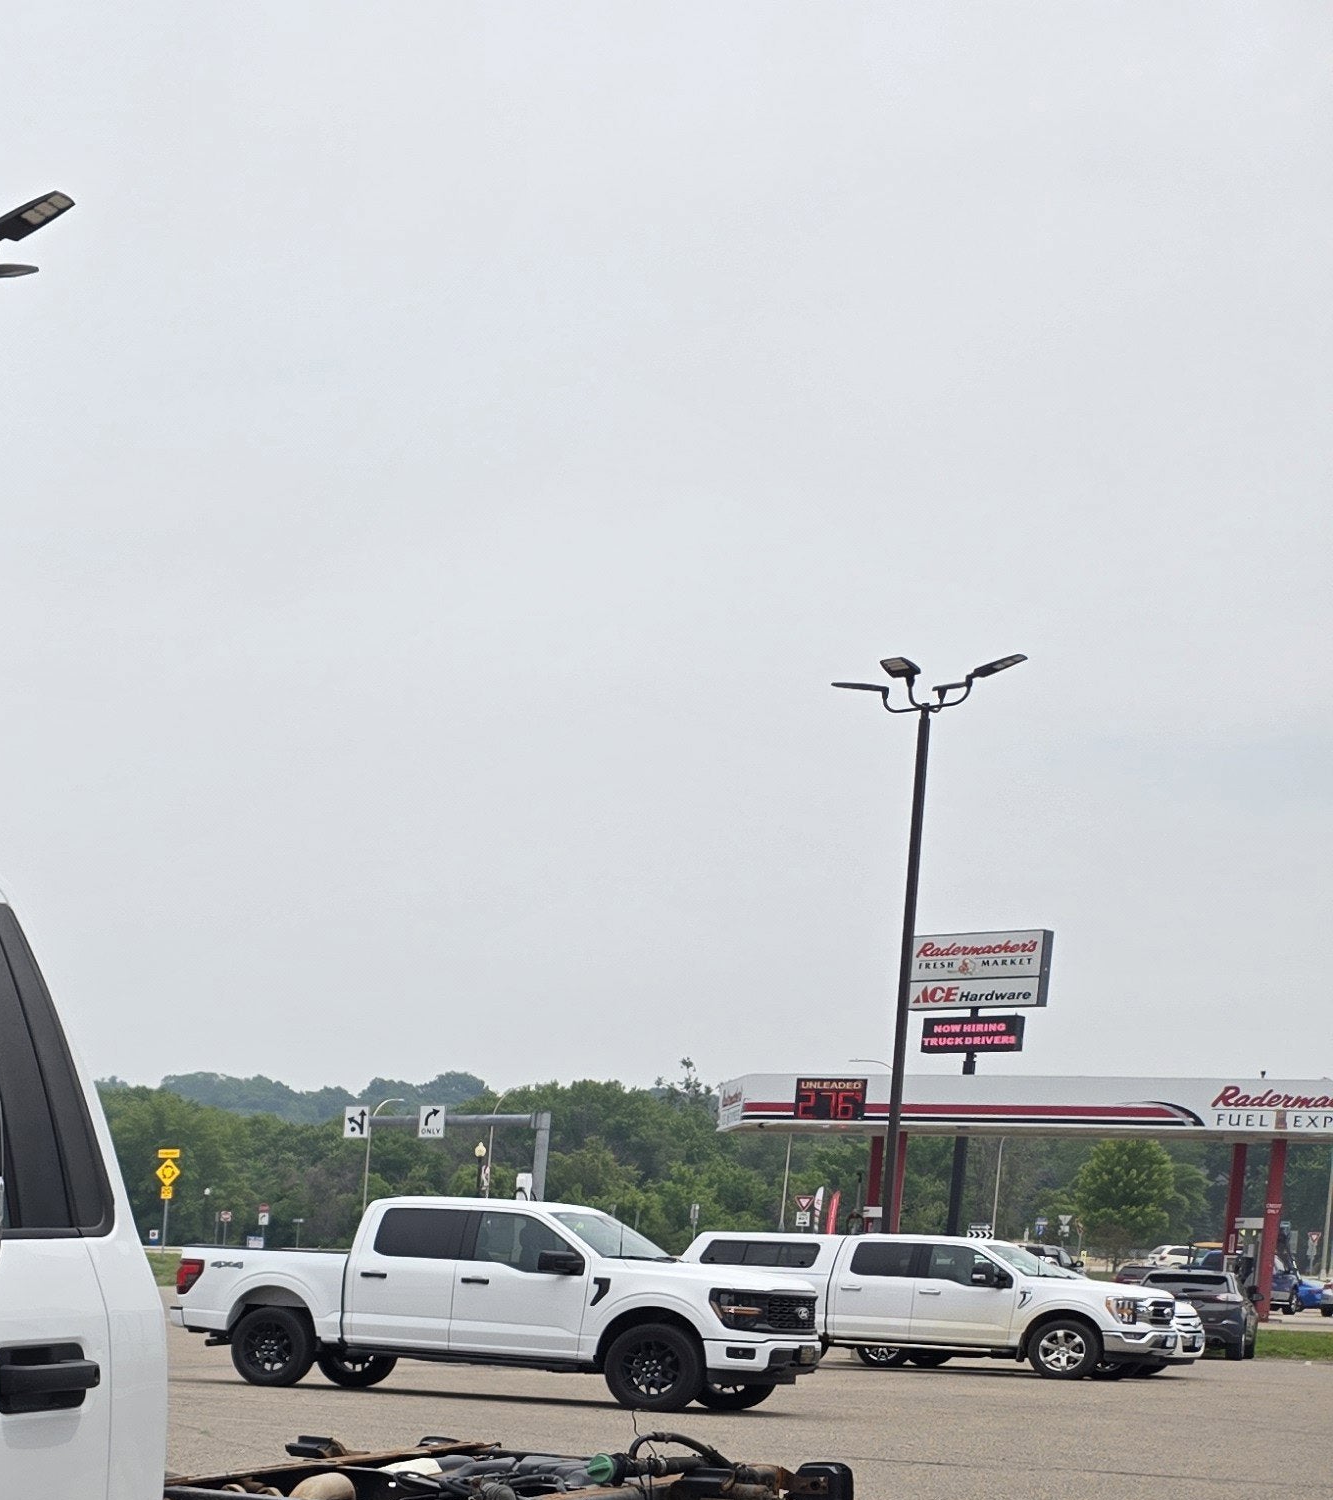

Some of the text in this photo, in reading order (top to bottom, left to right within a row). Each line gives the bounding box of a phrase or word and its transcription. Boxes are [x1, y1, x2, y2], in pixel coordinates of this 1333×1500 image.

[916, 940, 1038, 958] Radermacher's
[918, 958, 1033, 970] FRESH MARKET
[912, 986, 1032, 1004] ACE Hardware
[934, 1023, 1006, 1033] NOW HIRING
[923, 1035, 1016, 1046] TRUCK DRIVERS
[801, 1081, 862, 1090] UNLEADED
[1216, 1113, 1270, 1127] FUEL
[421, 1127, 441, 1135] ONLY
